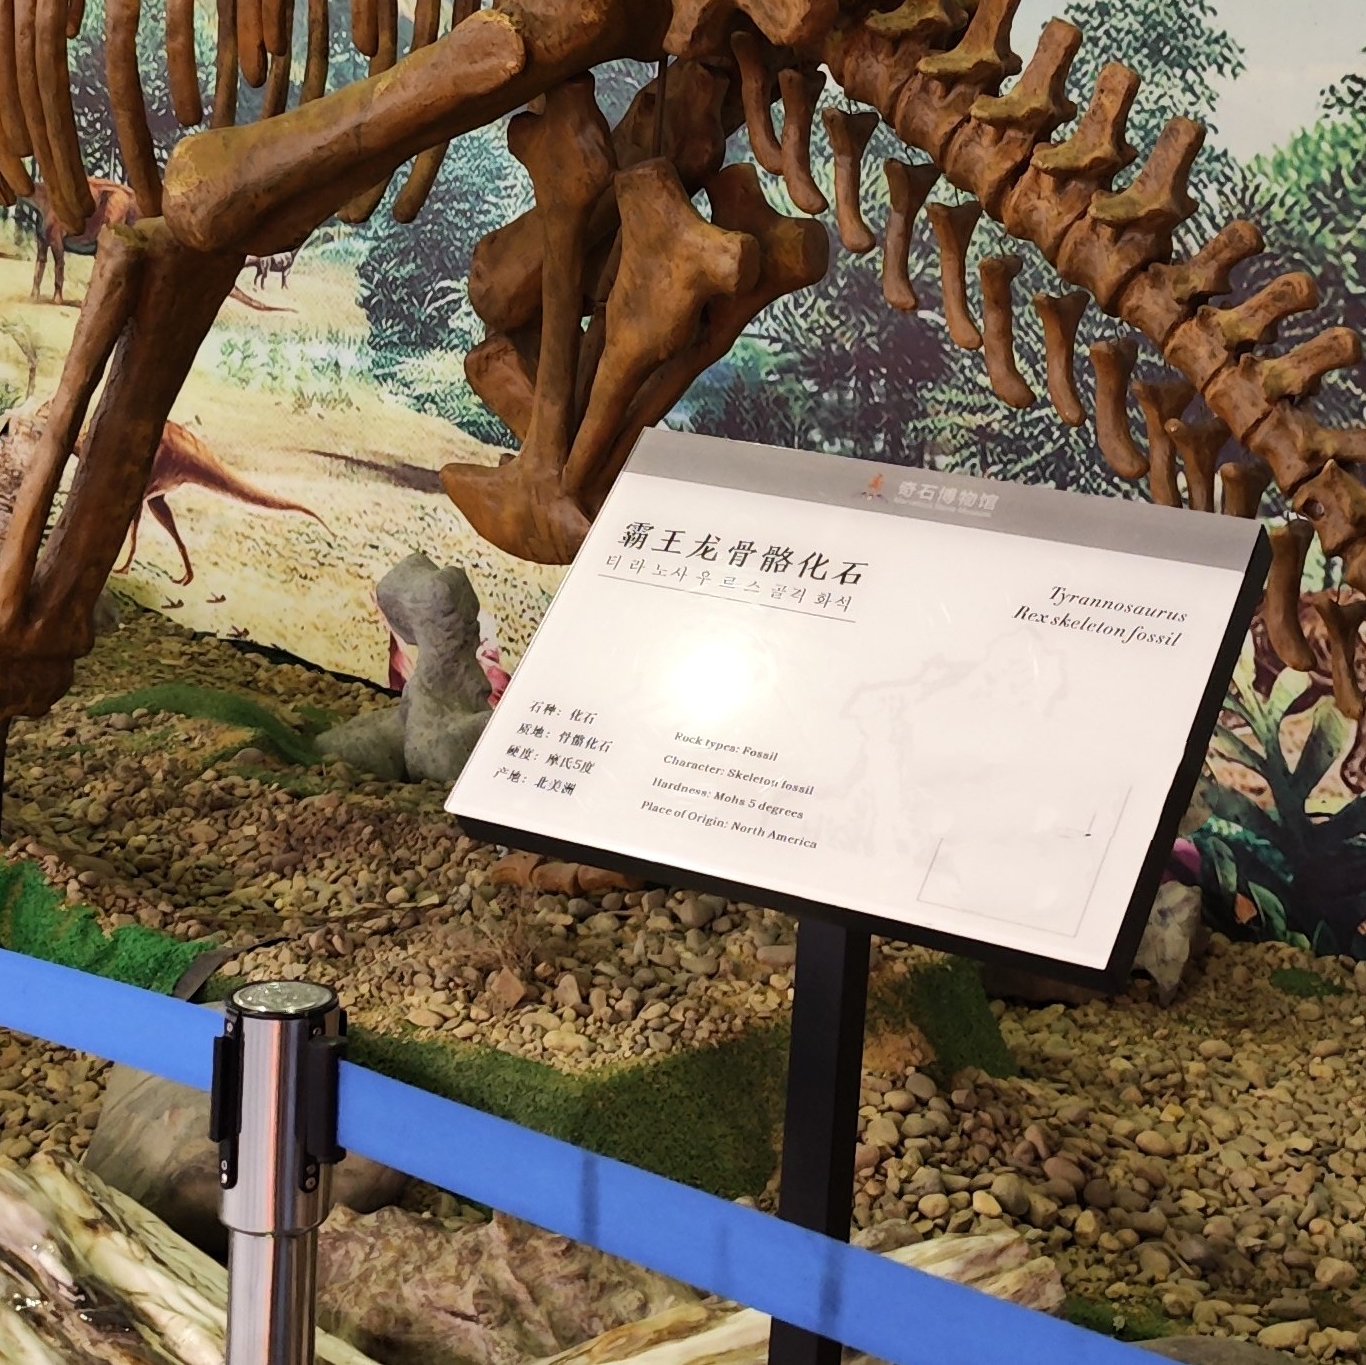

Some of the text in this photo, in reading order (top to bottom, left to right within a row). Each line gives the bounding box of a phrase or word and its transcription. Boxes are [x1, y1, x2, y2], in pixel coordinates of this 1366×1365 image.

[897, 481, 1000, 511] 奇石博物馆
[617, 521, 869, 586] 霸王龙骨骼化石
[1049, 586, 1188, 623] Tyrannosaurus
[1013, 605, 1182, 647] Rex skeleton fossil
[674, 731, 779, 762] Rock types: Fossil
[663, 754, 815, 796] Character: Skeleton fossil
[652, 777, 804, 820] Hardness: Mohs 5 degrees
[641, 800, 818, 849] Place of Origin: North America
